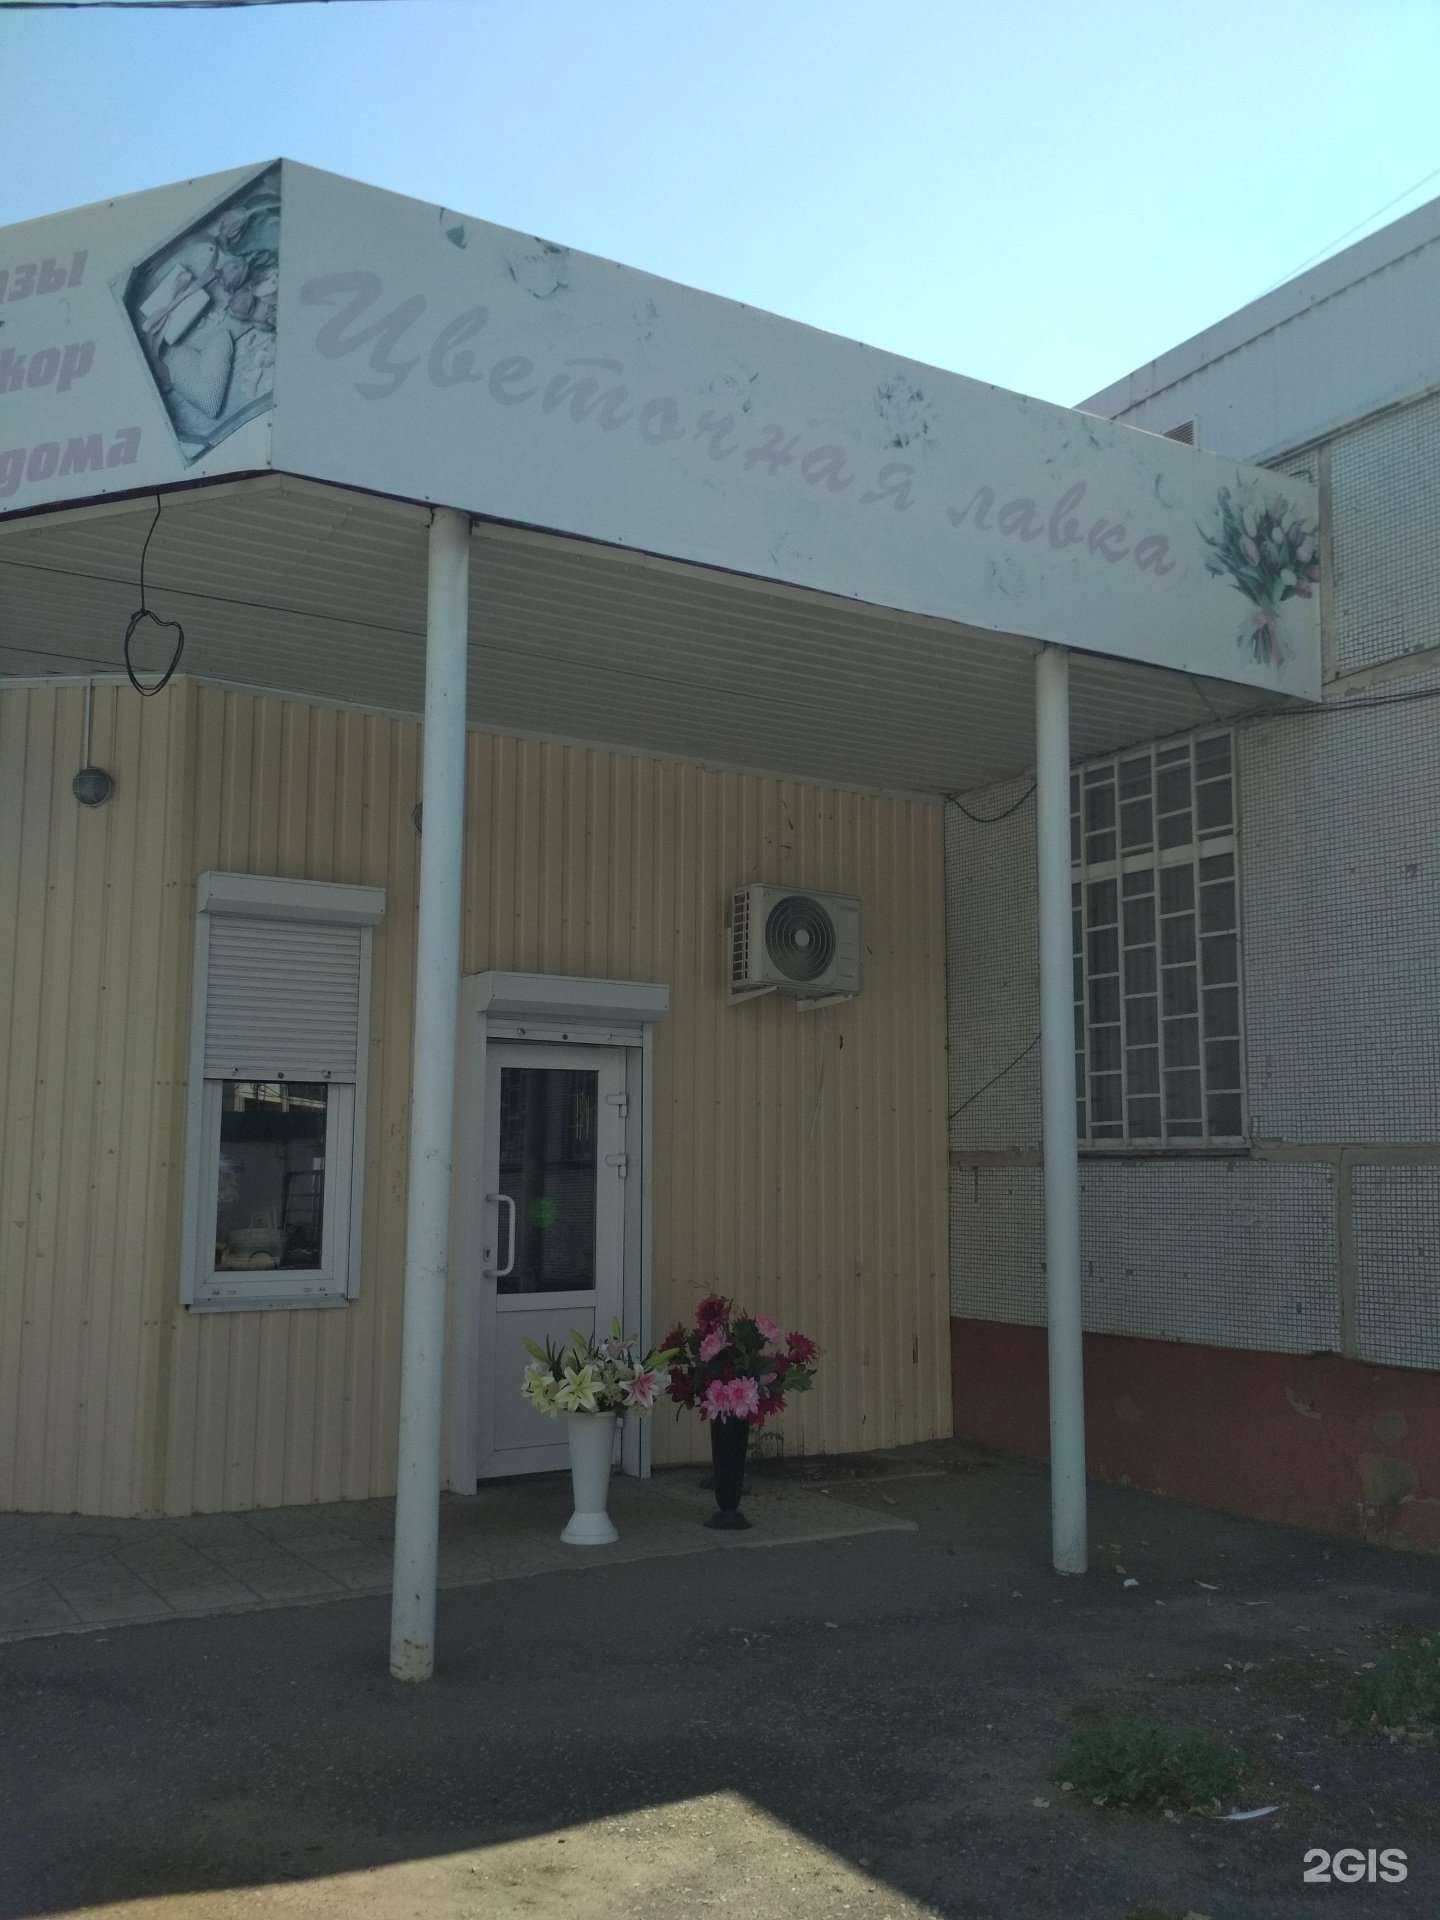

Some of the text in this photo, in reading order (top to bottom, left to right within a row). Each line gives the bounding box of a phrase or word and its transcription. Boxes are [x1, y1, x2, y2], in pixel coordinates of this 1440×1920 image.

[0, 426, 142, 497] дома
[301, 270, 1177, 576] Цветочная лавка
